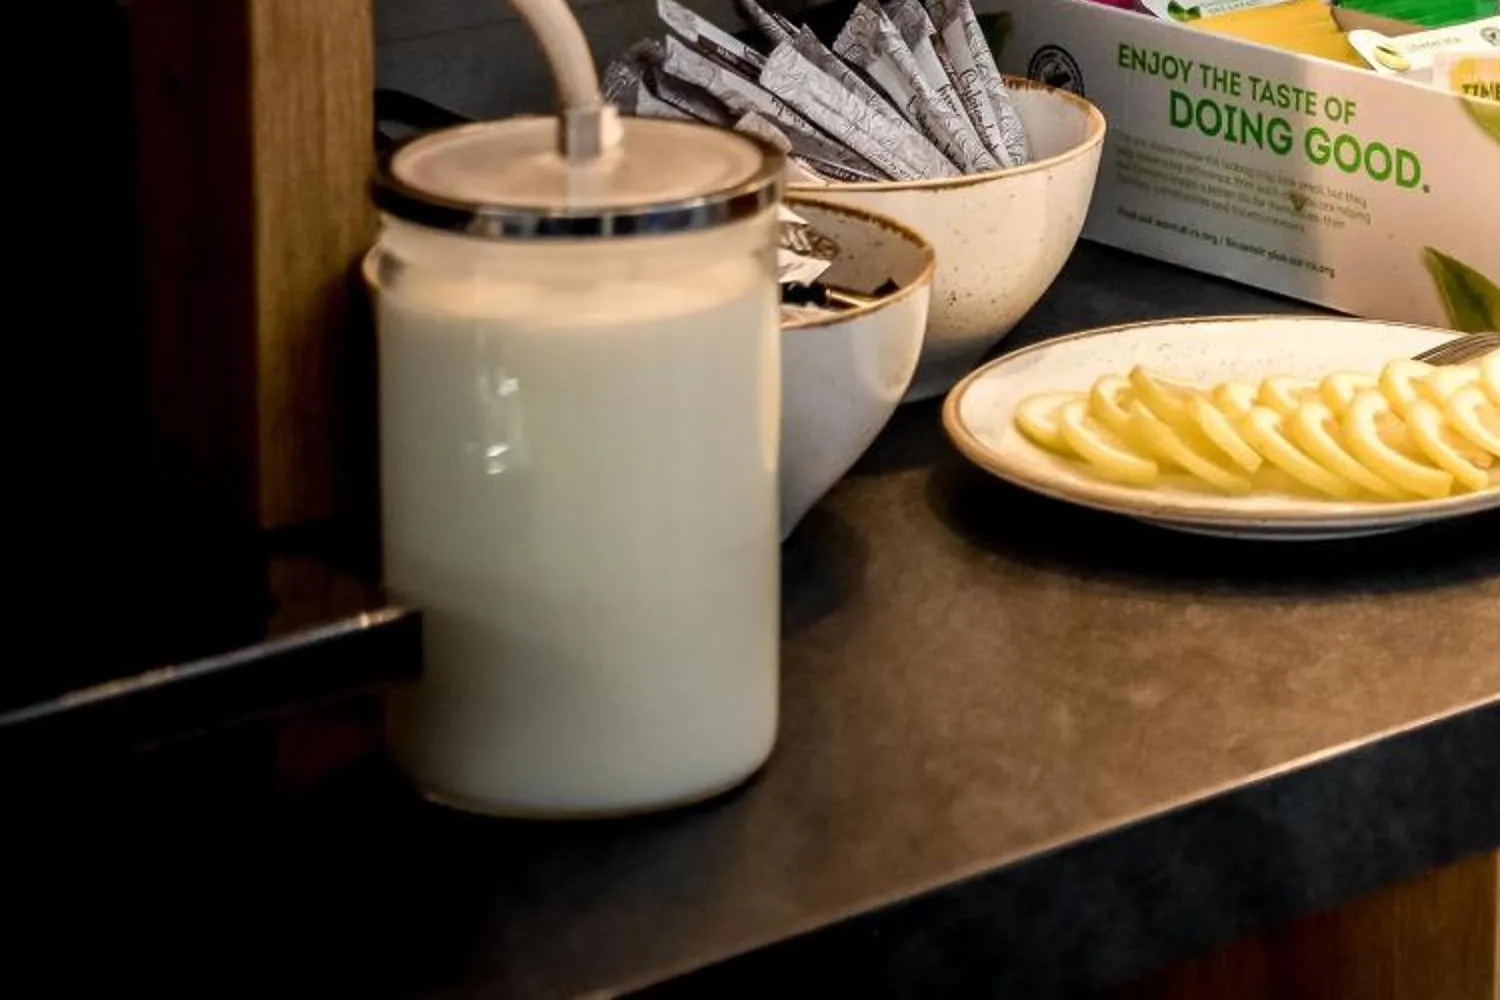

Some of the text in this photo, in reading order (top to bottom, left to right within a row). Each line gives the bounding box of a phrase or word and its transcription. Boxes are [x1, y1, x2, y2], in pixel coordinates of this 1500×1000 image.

[1118, 43, 1194, 83] ENJOY
[1199, 64, 1242, 97] THE
[1248, 76, 1317, 117] TASTE
[1324, 96, 1357, 125] OF
[1169, 88, 1293, 156] DOING
[1305, 126, 1431, 194] GOOD.
